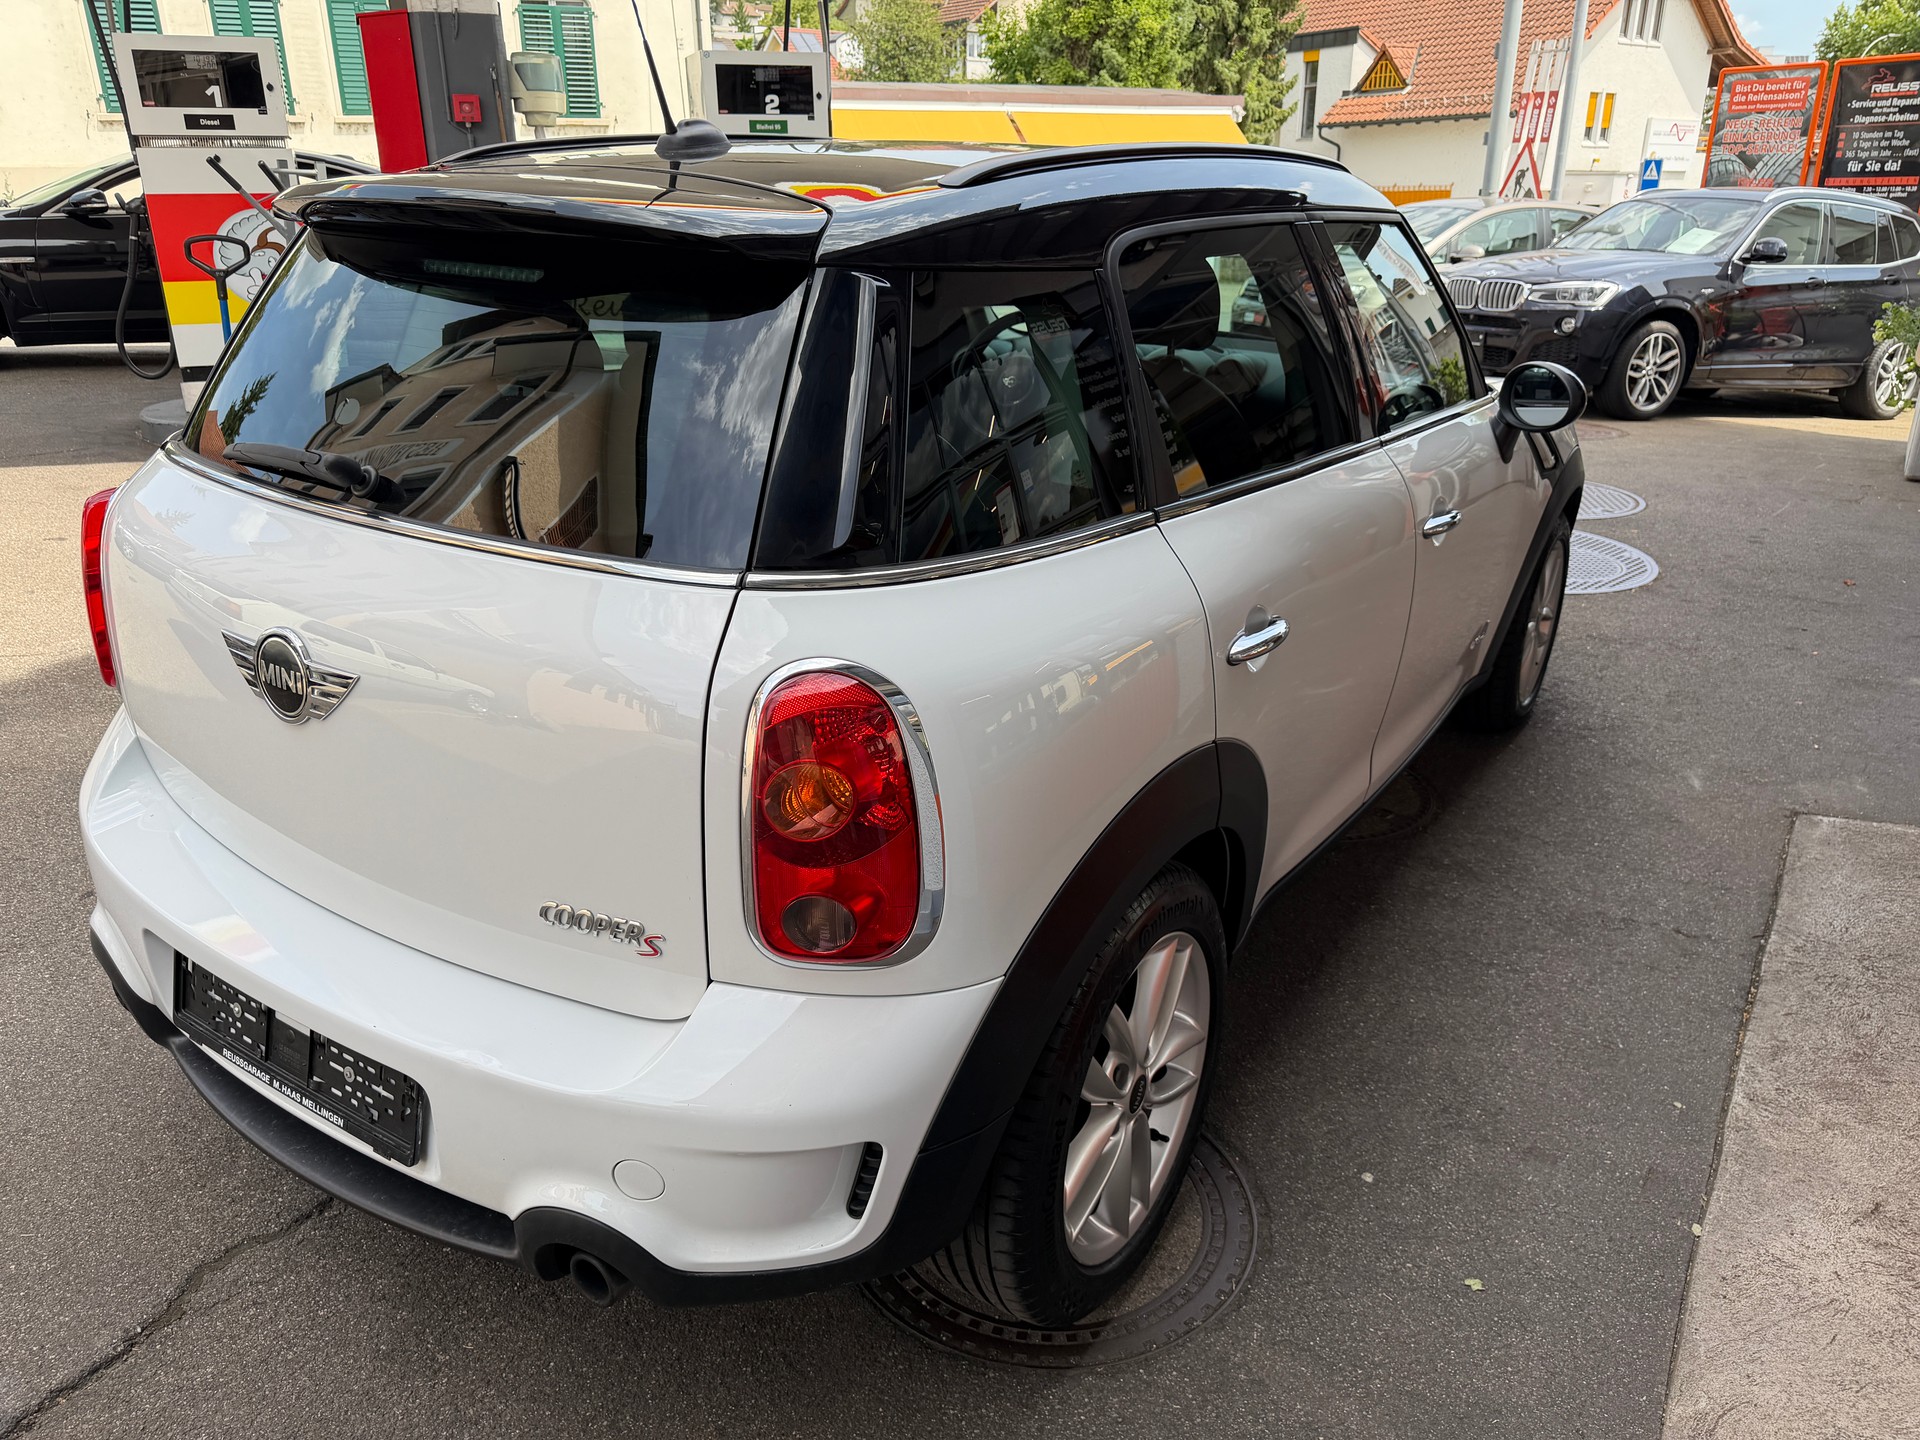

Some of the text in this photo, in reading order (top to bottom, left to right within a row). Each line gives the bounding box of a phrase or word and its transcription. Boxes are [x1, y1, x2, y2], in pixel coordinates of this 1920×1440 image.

[1735, 80, 1806, 93] Bist Du bereit für
[1871, 81, 1920, 93] REUSS
[205, 85, 223, 108] 1
[1733, 91, 1806, 103] die Reifensaison?
[765, 94, 780, 115] 2
[1851, 99, 1877, 108] Service
[1877, 98, 1892, 107] und
[200, 118, 220, 126] Diesel
[1725, 117, 1804, 130] NEUE REIFEN!
[1854, 112, 1919, 125] Diagnose-Arbeiten
[1722, 130, 1801, 142] EINLAGERUNG!
[1860, 130, 1883, 139] Stunden
[1884, 130, 1892, 138] im
[1894, 129, 1904, 139] Tag
[1721, 143, 1798, 155] TOP-SERVICE!
[1853, 140, 1858, 148] 6
[1859, 140, 1872, 149] Tage
[1880, 139, 1890, 147] der
[1891, 138, 1911, 147] Woche
[1845, 150, 1855, 158] 365
[1857, 149, 1870, 159] Tage
[1879, 148, 1892, 157] Jahr
[1903, 148, 1920, 157] (fast)
[1847, 159, 1902, 172] für Sie da!
[260, 659, 303, 696] MINI
[539, 900, 666, 958] COOPER S
[222, 1048, 271, 1084] REUSSGARAGE
[302, 1096, 344, 1128] MELLINGEN
